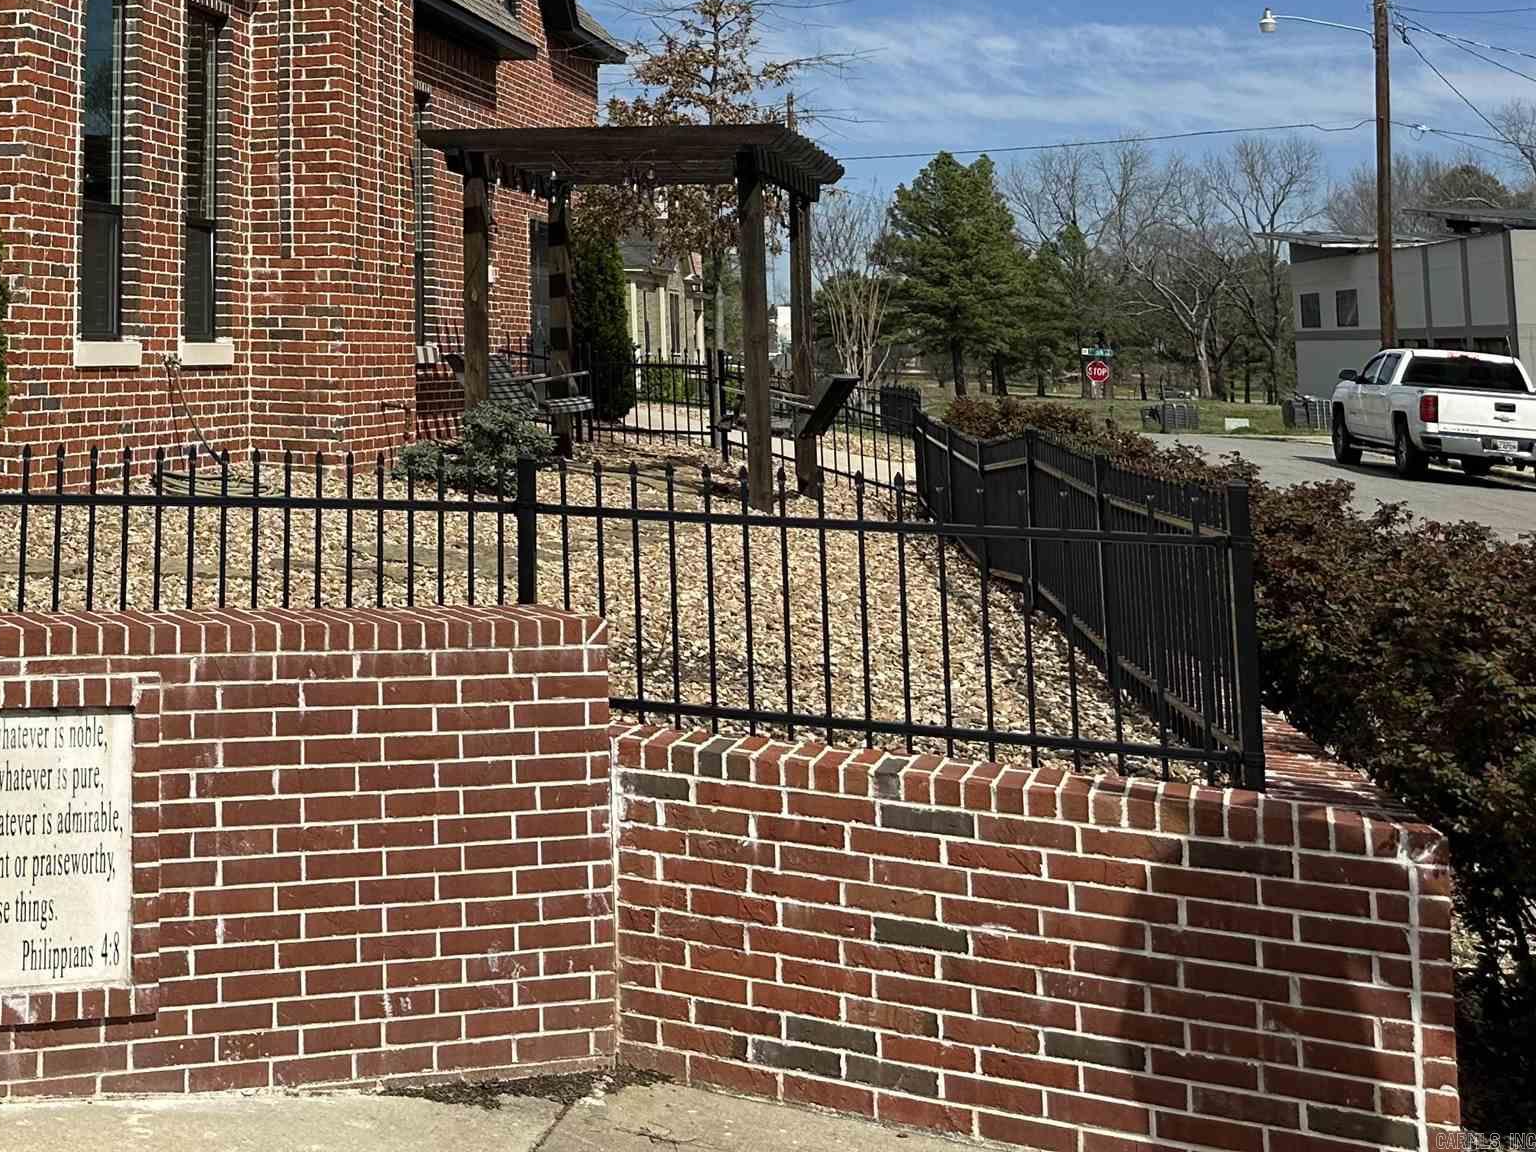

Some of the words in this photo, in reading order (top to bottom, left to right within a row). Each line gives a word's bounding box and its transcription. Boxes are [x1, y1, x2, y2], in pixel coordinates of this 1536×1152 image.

[1088, 367, 1107, 376] STOP
[54, 716, 65, 749] is
[69, 716, 108, 752] noble,
[57, 757, 68, 790] is
[72, 766, 104, 798] pure,
[41, 802, 52, 835] is
[57, 800, 124, 838] admirable,
[14, 855, 28, 878] or
[32, 842, 116, 886] praiseworthy,
[14, 890, 58, 930] things.
[21, 936, 94, 979] Philippians
[100, 931, 120, 967] 4:8
